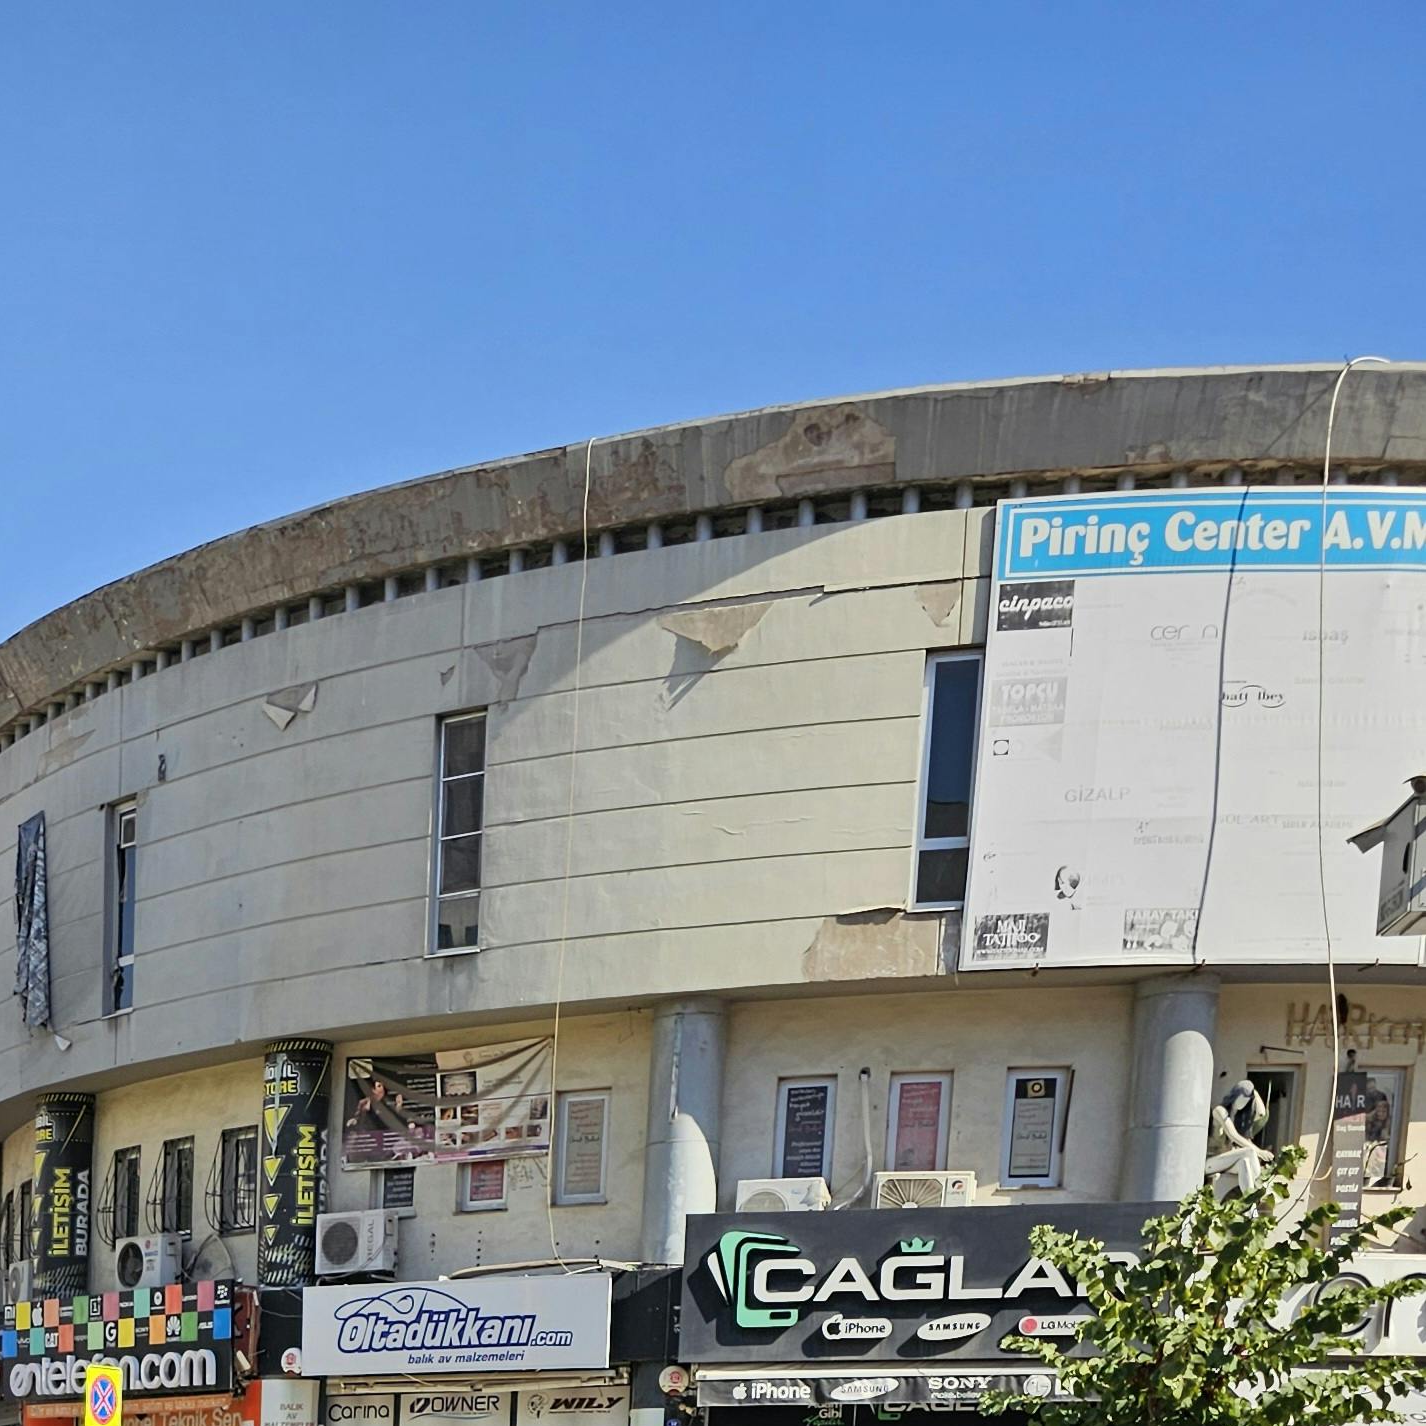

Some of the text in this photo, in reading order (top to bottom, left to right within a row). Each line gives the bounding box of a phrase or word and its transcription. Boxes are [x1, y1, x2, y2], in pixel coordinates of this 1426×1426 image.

[1019, 514, 1150, 565] Pirinç
[1164, 510, 1311, 552] Center
[1150, 623, 1218, 641] cern
[75, 1169, 90, 1256] BURADA
[845, 1321, 886, 1335] iPhone
[928, 1322, 982, 1331] SAMSUNG
[1040, 1320, 1056, 1330] LG
[408, 1354, 434, 1364] balık
[455, 1350, 525, 1363] malzemeleri
[9, 1348, 217, 1397] entelen.com
[751, 1382, 811, 1399] iPhone
[841, 1383, 890, 1394] SAMSUNG
[928, 1376, 993, 1390] SONY
[430, 1396, 500, 1412] OWNER
[328, 1403, 390, 1422] Carina
